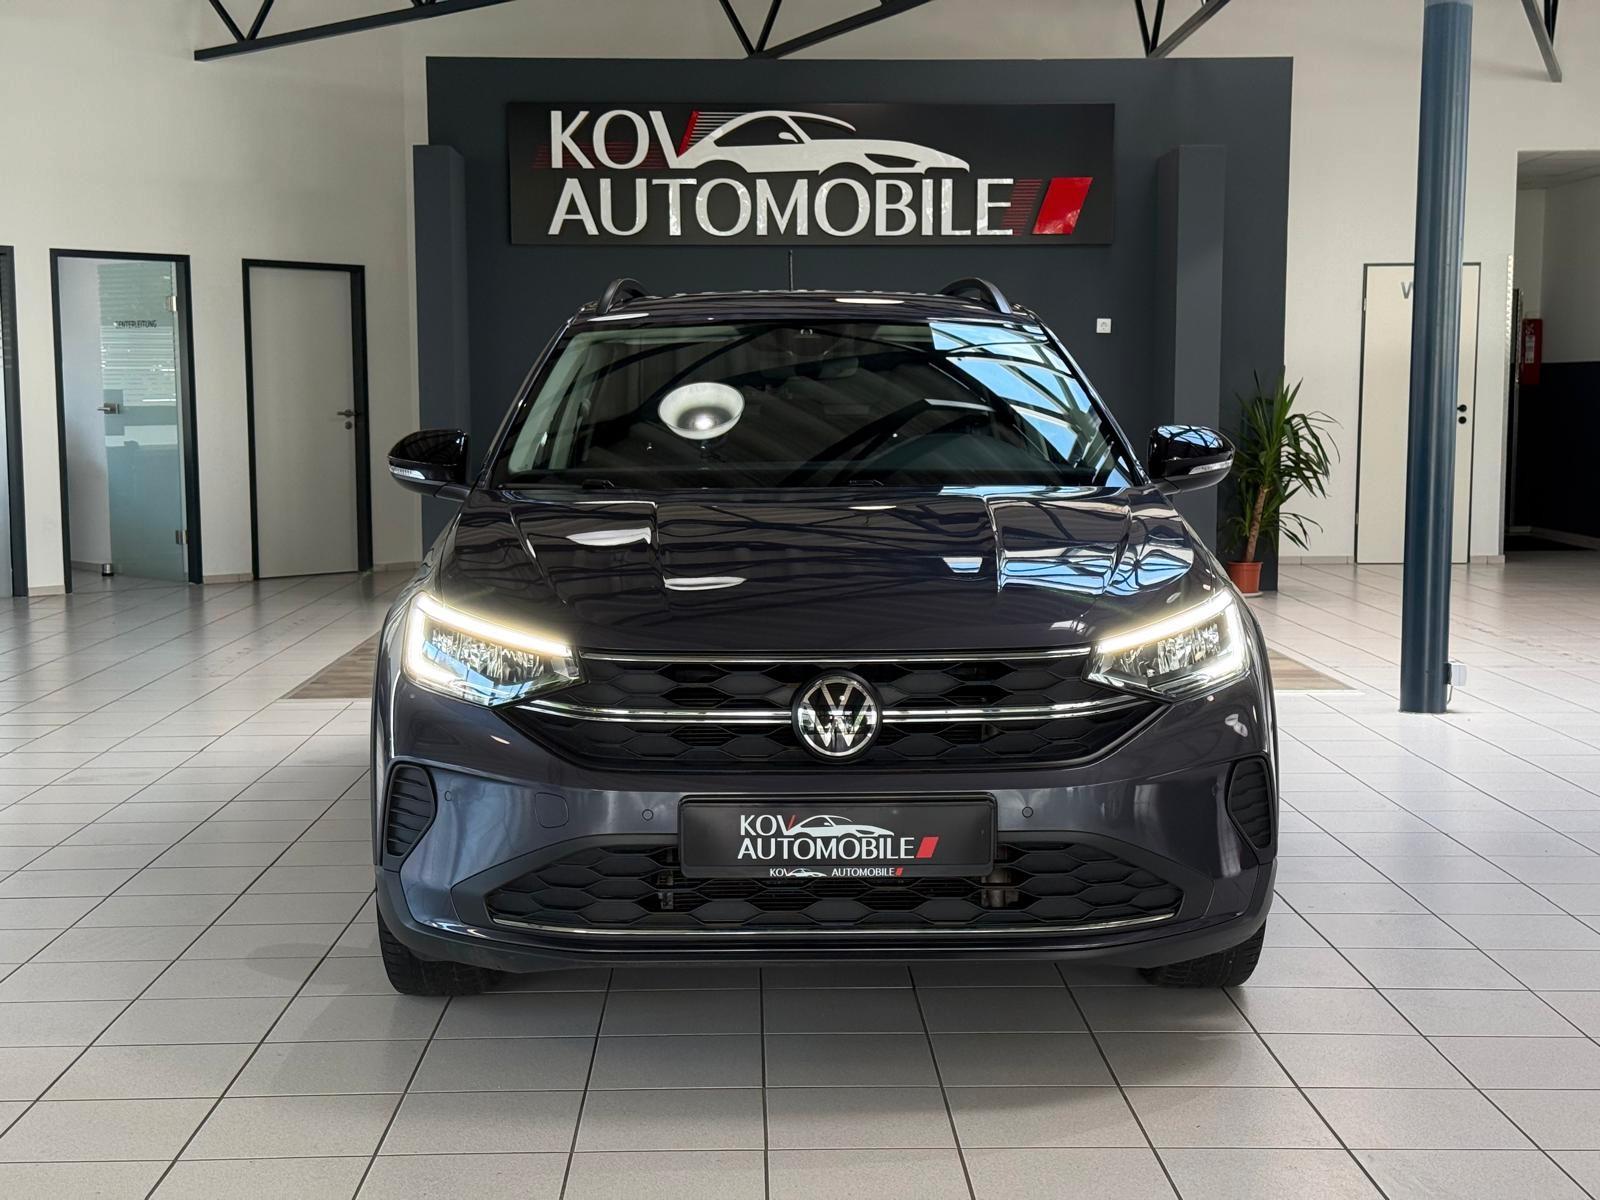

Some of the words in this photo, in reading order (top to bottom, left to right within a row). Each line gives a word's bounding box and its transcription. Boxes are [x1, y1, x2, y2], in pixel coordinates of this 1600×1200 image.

[550, 109, 699, 169] KOV
[547, 177, 1014, 237] AUTOMOBILE
[739, 814, 795, 836] KOV
[737, 837, 915, 860] AUTOMOBILE
[769, 867, 791, 877] KOV
[831, 867, 895, 877] AUTOMOBILE
